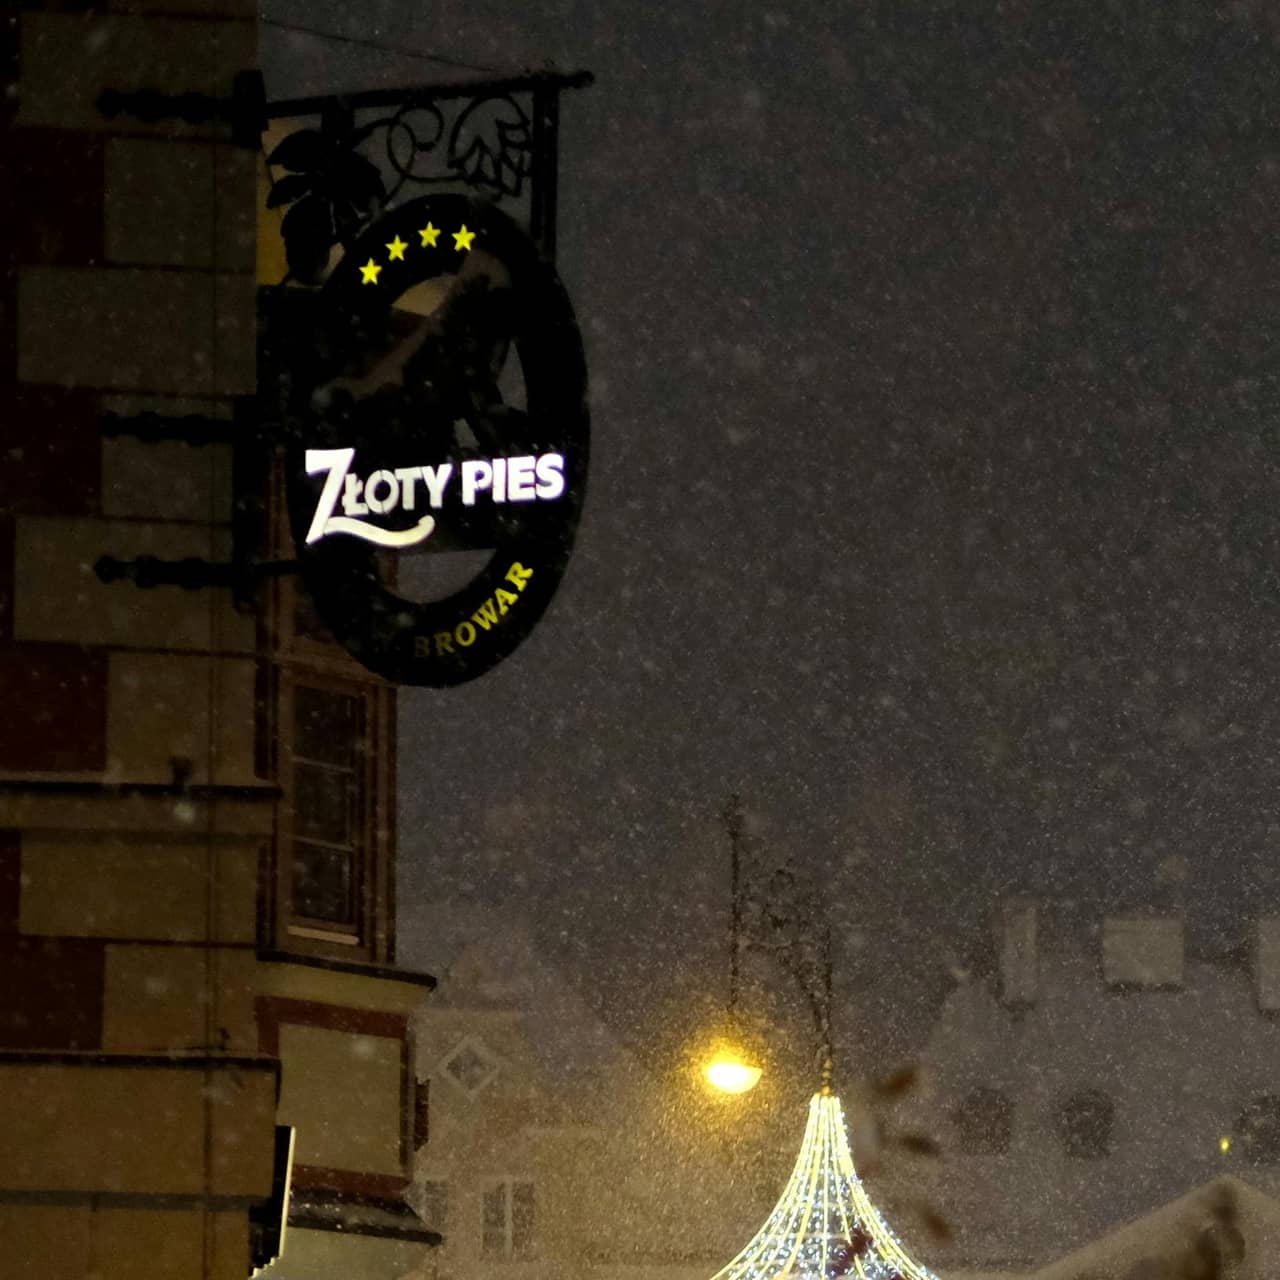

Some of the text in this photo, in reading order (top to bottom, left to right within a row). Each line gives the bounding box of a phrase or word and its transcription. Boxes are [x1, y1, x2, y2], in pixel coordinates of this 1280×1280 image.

[305, 447, 565, 549] ZŁOTY PIES
[413, 561, 535, 660] BROWAR
